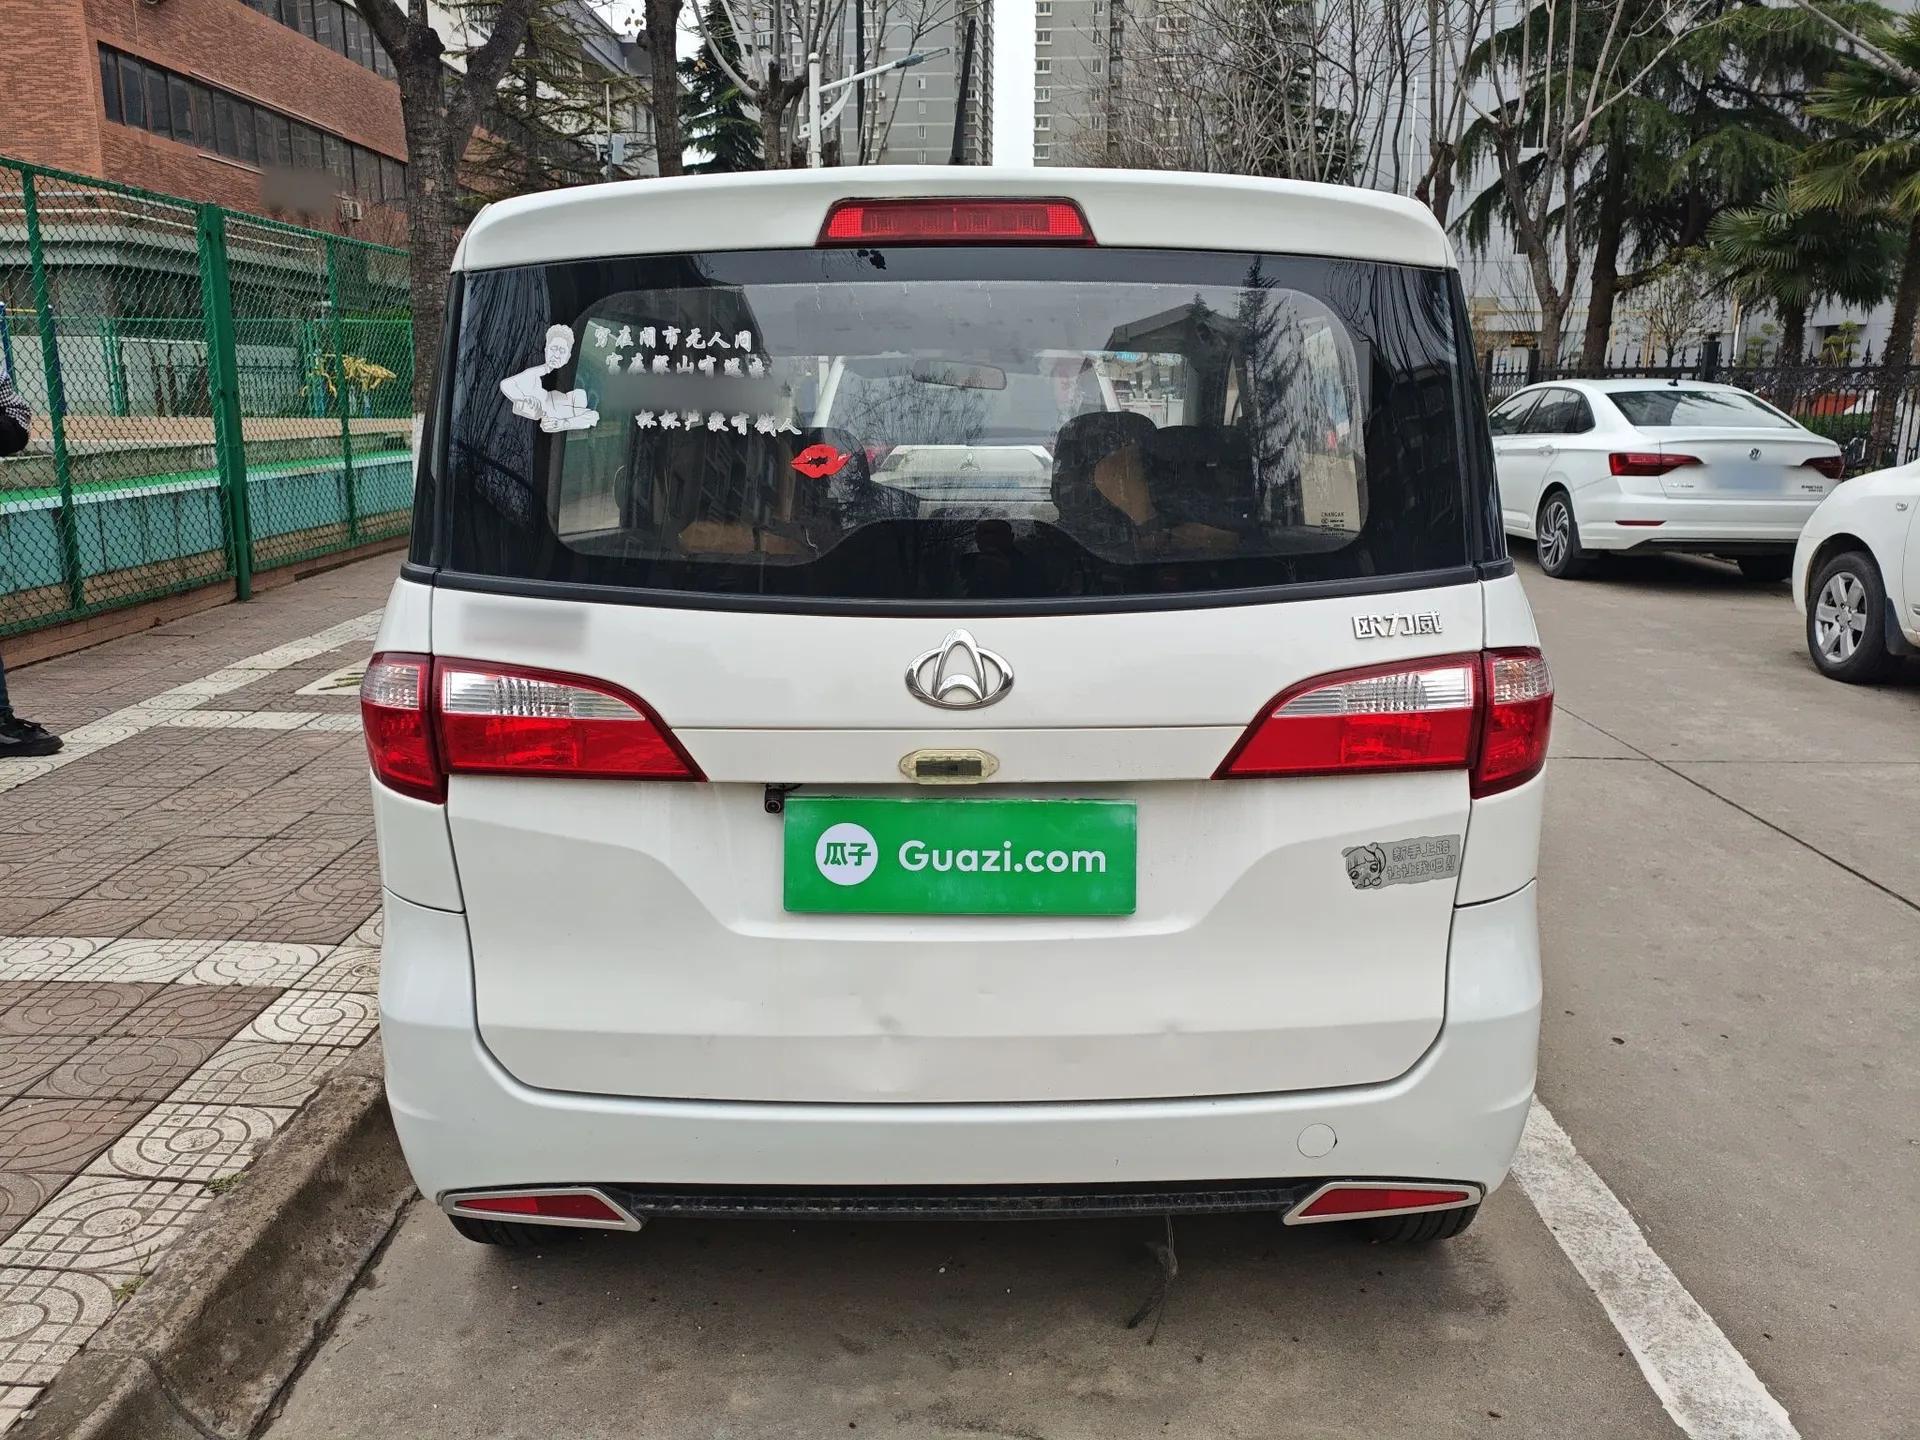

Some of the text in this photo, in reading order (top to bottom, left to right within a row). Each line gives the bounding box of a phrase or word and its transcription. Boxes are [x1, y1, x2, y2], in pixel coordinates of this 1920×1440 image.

[595, 325, 752, 352] 穷在闹市无人问
[1352, 610, 1443, 639] 欧力威
[824, 842, 872, 867] 瓜子
[898, 840, 1107, 873] Guazi.com
